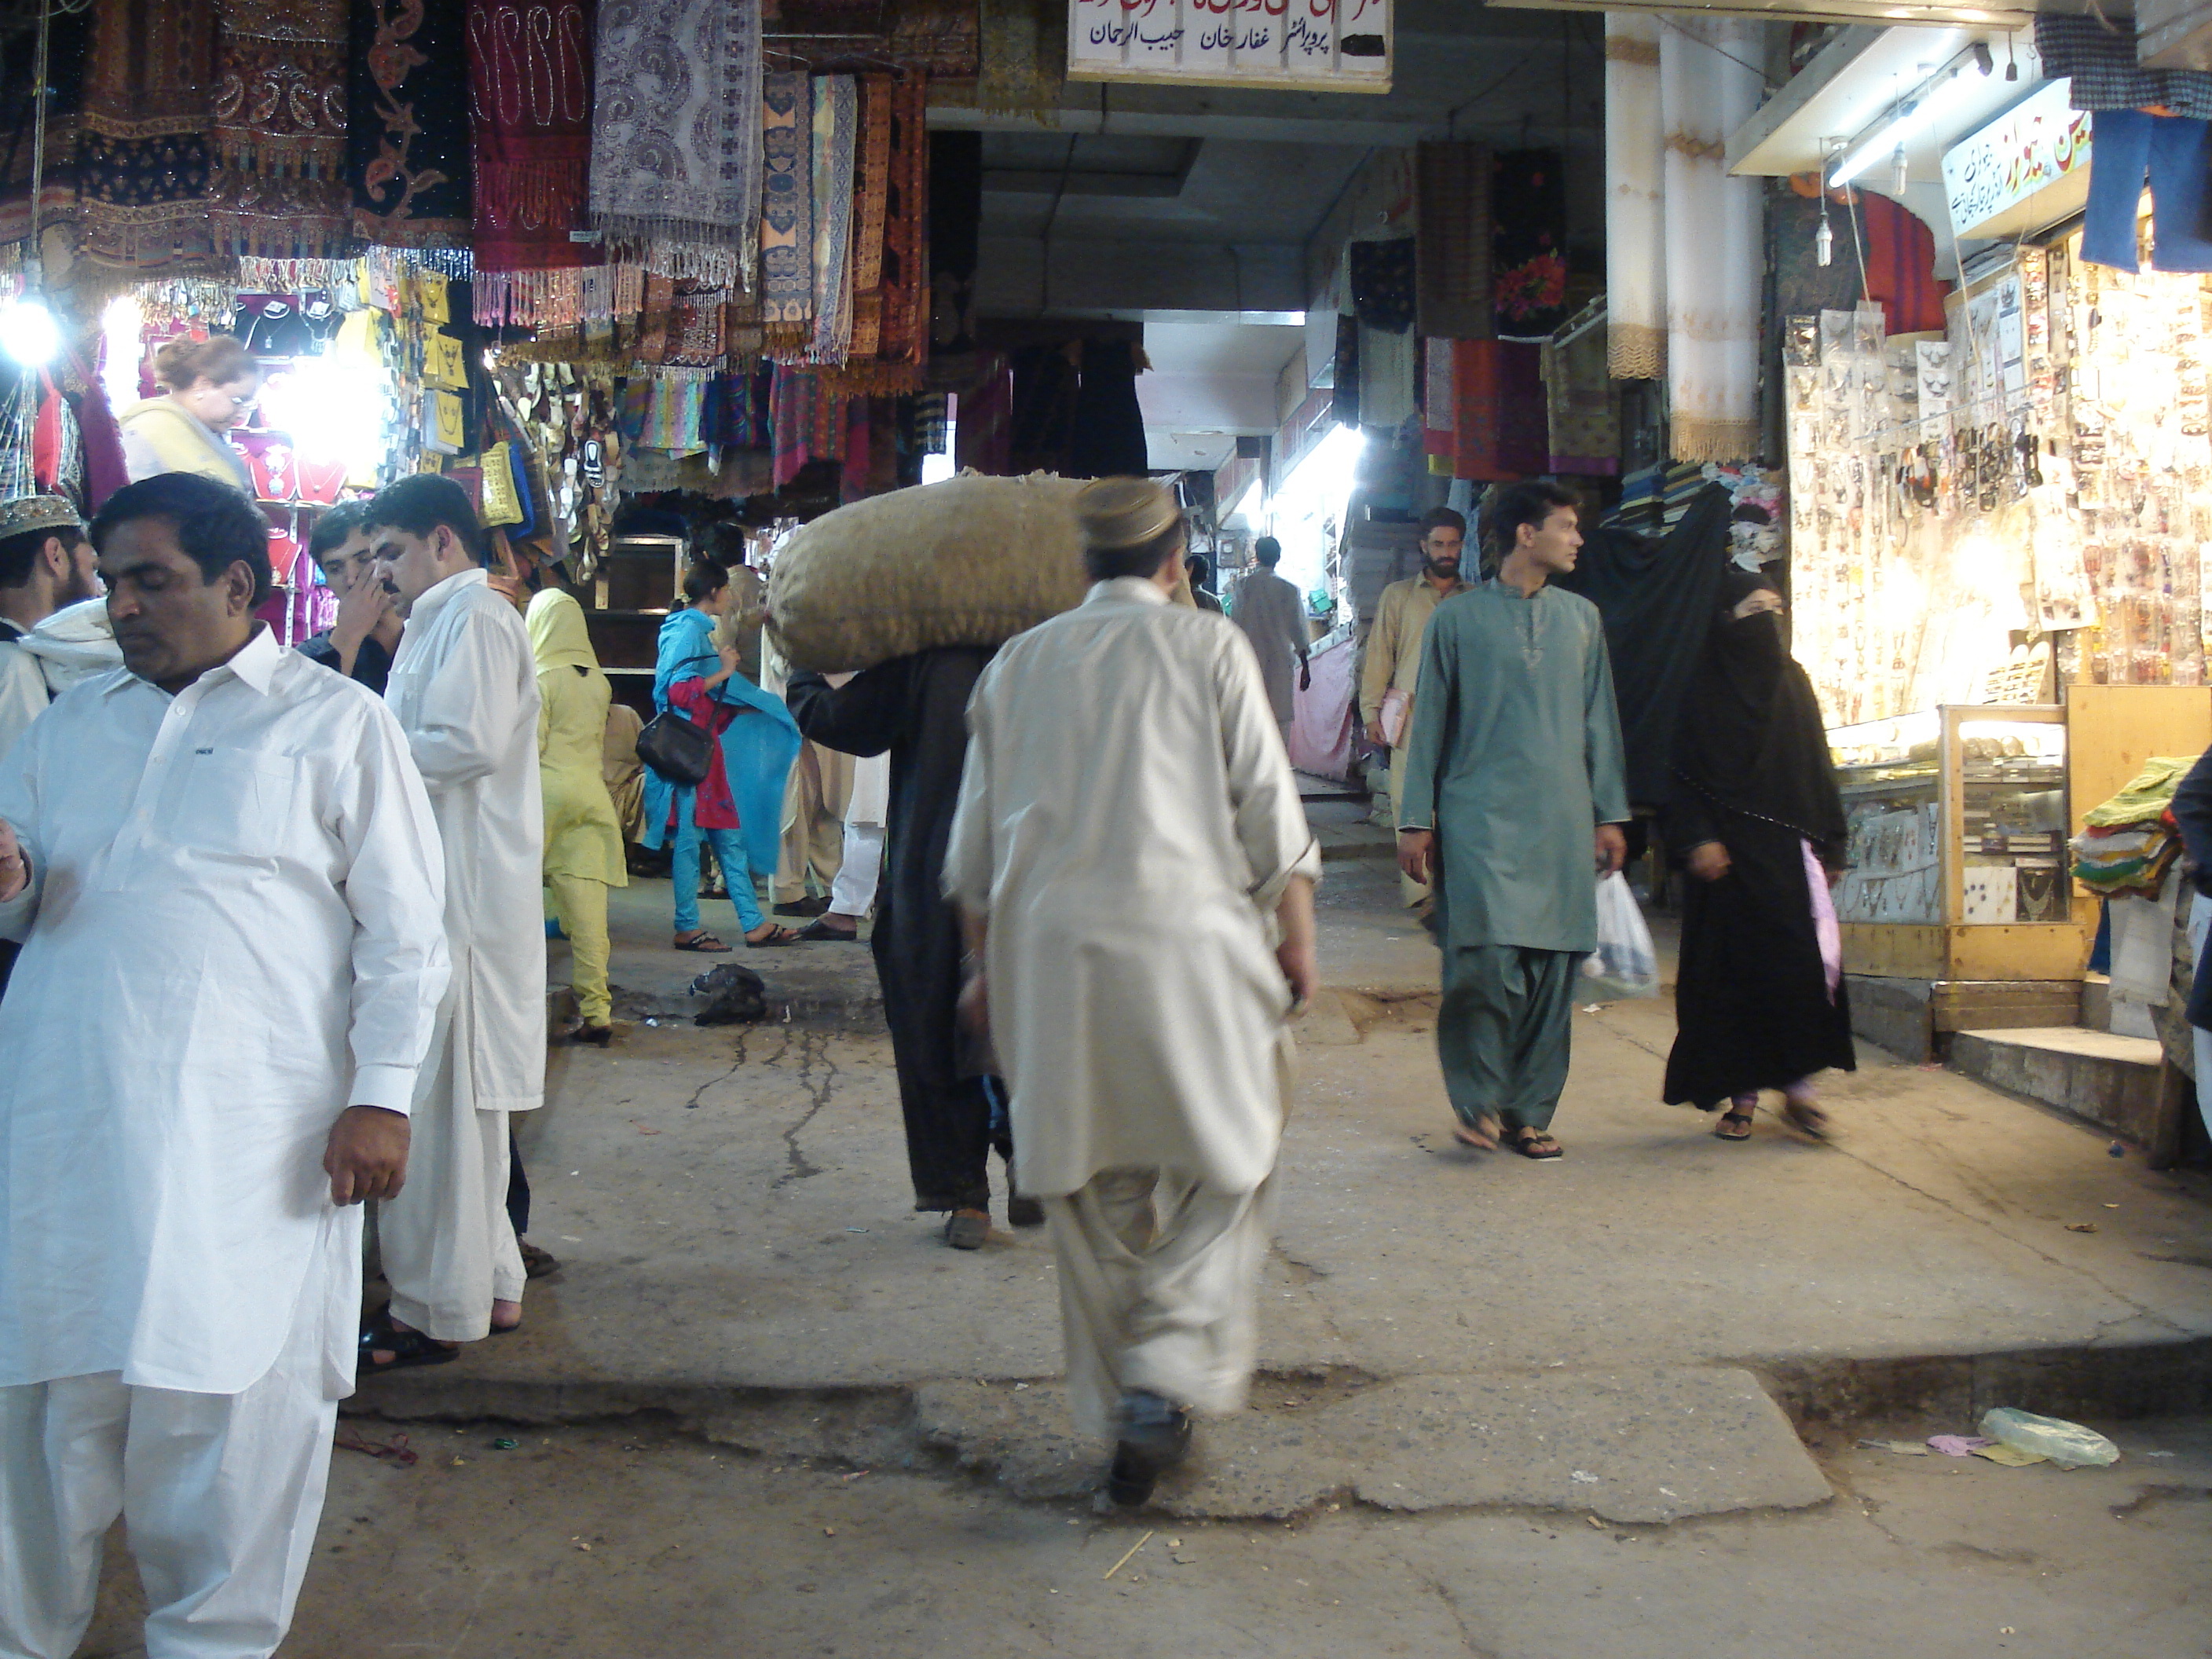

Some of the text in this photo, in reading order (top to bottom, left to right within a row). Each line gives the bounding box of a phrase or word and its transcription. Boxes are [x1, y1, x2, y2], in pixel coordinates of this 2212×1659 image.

[1090, 20, 1138, 46] الرحمان
[1140, 29, 1185, 51] حبیب
[1200, 23, 1234, 50] خان
[1235, 27, 1269, 50] غفار
